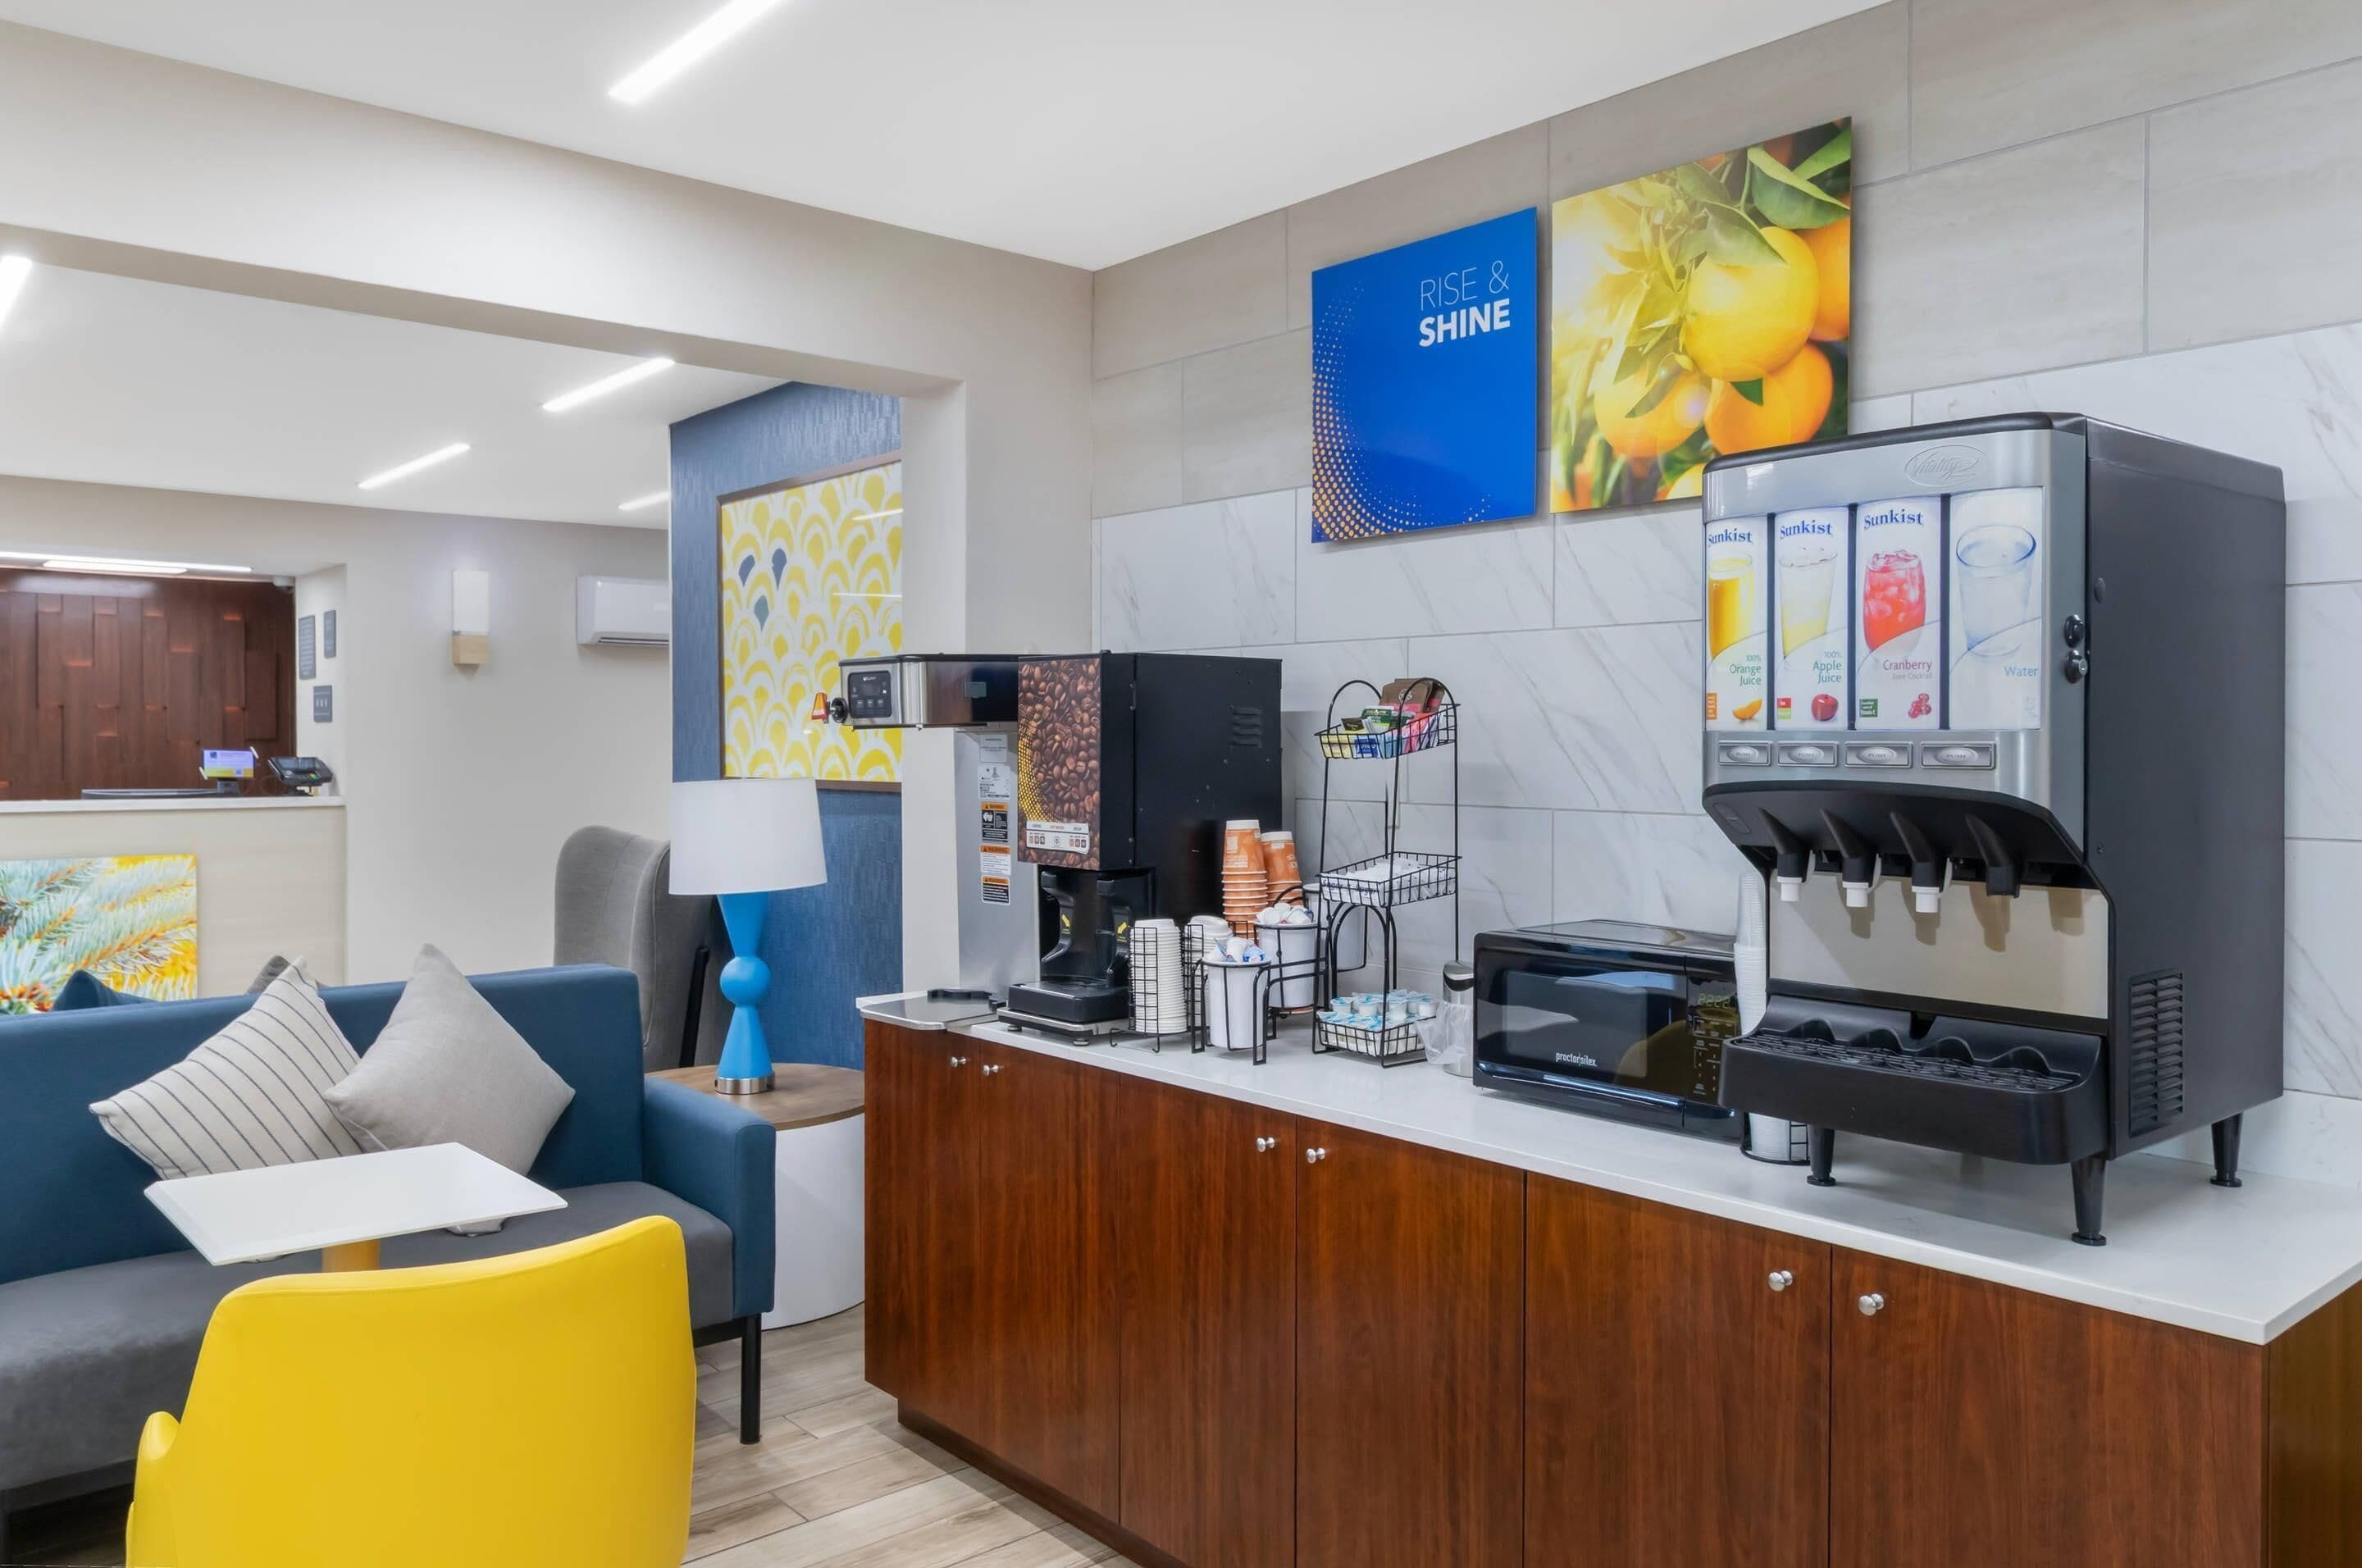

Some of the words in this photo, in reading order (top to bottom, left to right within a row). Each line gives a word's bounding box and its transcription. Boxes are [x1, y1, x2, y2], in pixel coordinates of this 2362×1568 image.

[1420, 267, 1477, 311] RISE
[1489, 260, 1509, 294] &
[1419, 298, 1511, 347] SHINE
[1863, 508, 1925, 530] Sunkist
[1779, 519, 1834, 540] Sunkist
[1708, 527, 1753, 548] Sunkist
[1824, 650, 1843, 659] 100%
[1729, 663, 1762, 676] Orange
[1813, 660, 1842, 672] Apple
[1882, 659, 1933, 672] Cranberry
[2004, 666, 2039, 677] Water
[1739, 676, 1762, 687] Juice
[1817, 673, 1842, 684] Juice
